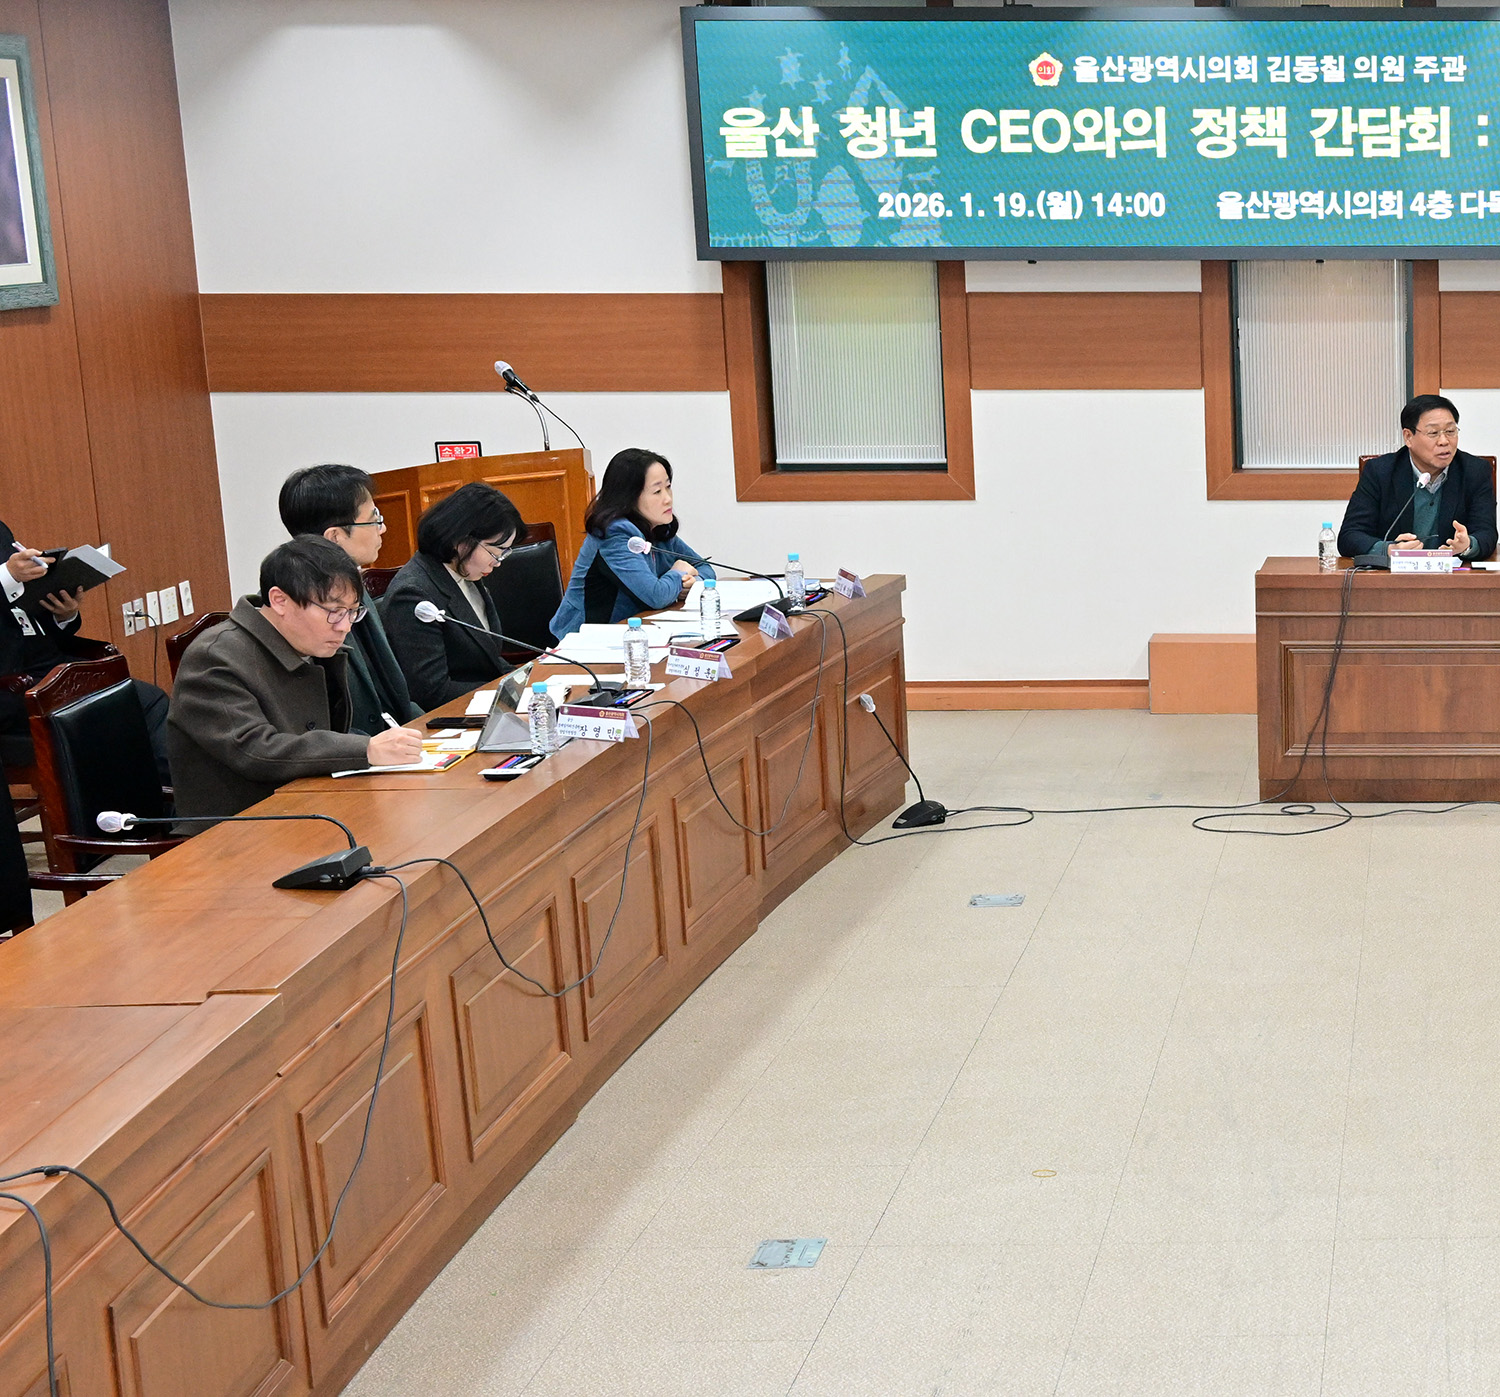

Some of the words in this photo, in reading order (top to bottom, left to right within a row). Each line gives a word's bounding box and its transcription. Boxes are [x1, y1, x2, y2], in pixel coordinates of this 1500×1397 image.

[1073, 55, 1258, 82] 울산광역시의회
[1267, 55, 1345, 82] 김동칠
[1353, 55, 1405, 82] 의원
[1413, 55, 1467, 82] 주관
[719, 106, 820, 157] 울산
[839, 106, 937, 158] 청년
[961, 106, 1167, 158] CEO와의
[1190, 106, 1287, 158] 정책
[1309, 106, 1451, 157] 간담회
[878, 192, 953, 217] 2026.
[960, 192, 985, 216] 1.
[993, 190, 1083, 219] 19.(월)
[1091, 191, 1166, 216] 14:00
[1216, 190, 1403, 219] 울산광역시의회
[1409, 190, 1455, 219] 4층
[442, 446, 476, 454] 소화기
